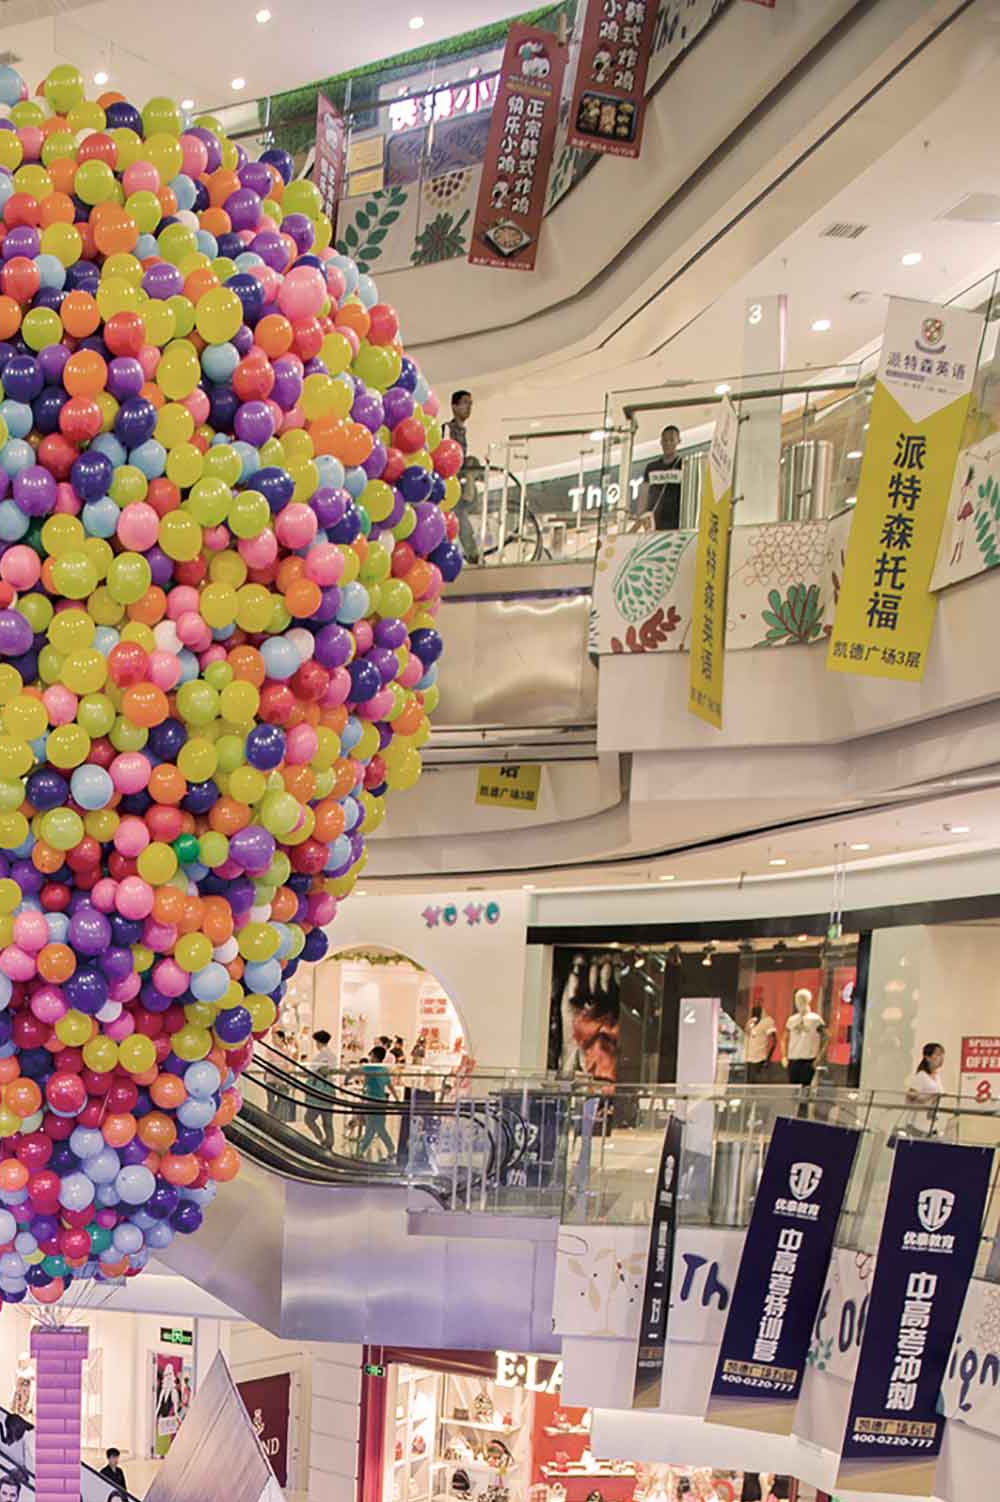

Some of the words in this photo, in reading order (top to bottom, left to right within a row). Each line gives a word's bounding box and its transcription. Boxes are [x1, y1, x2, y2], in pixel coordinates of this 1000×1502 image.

[748, 303, 763, 325] 3
[866, 432, 927, 631] 派特森托福
[832, 640, 921, 668] 凯德广场3层
[751, 1228, 804, 1362] 中高考特训营
[885, 1271, 938, 1412] 中高考冲刺
[721, 1374, 795, 1392] 400-0220-777
[851, 1433, 934, 1449] 400-0220-777
